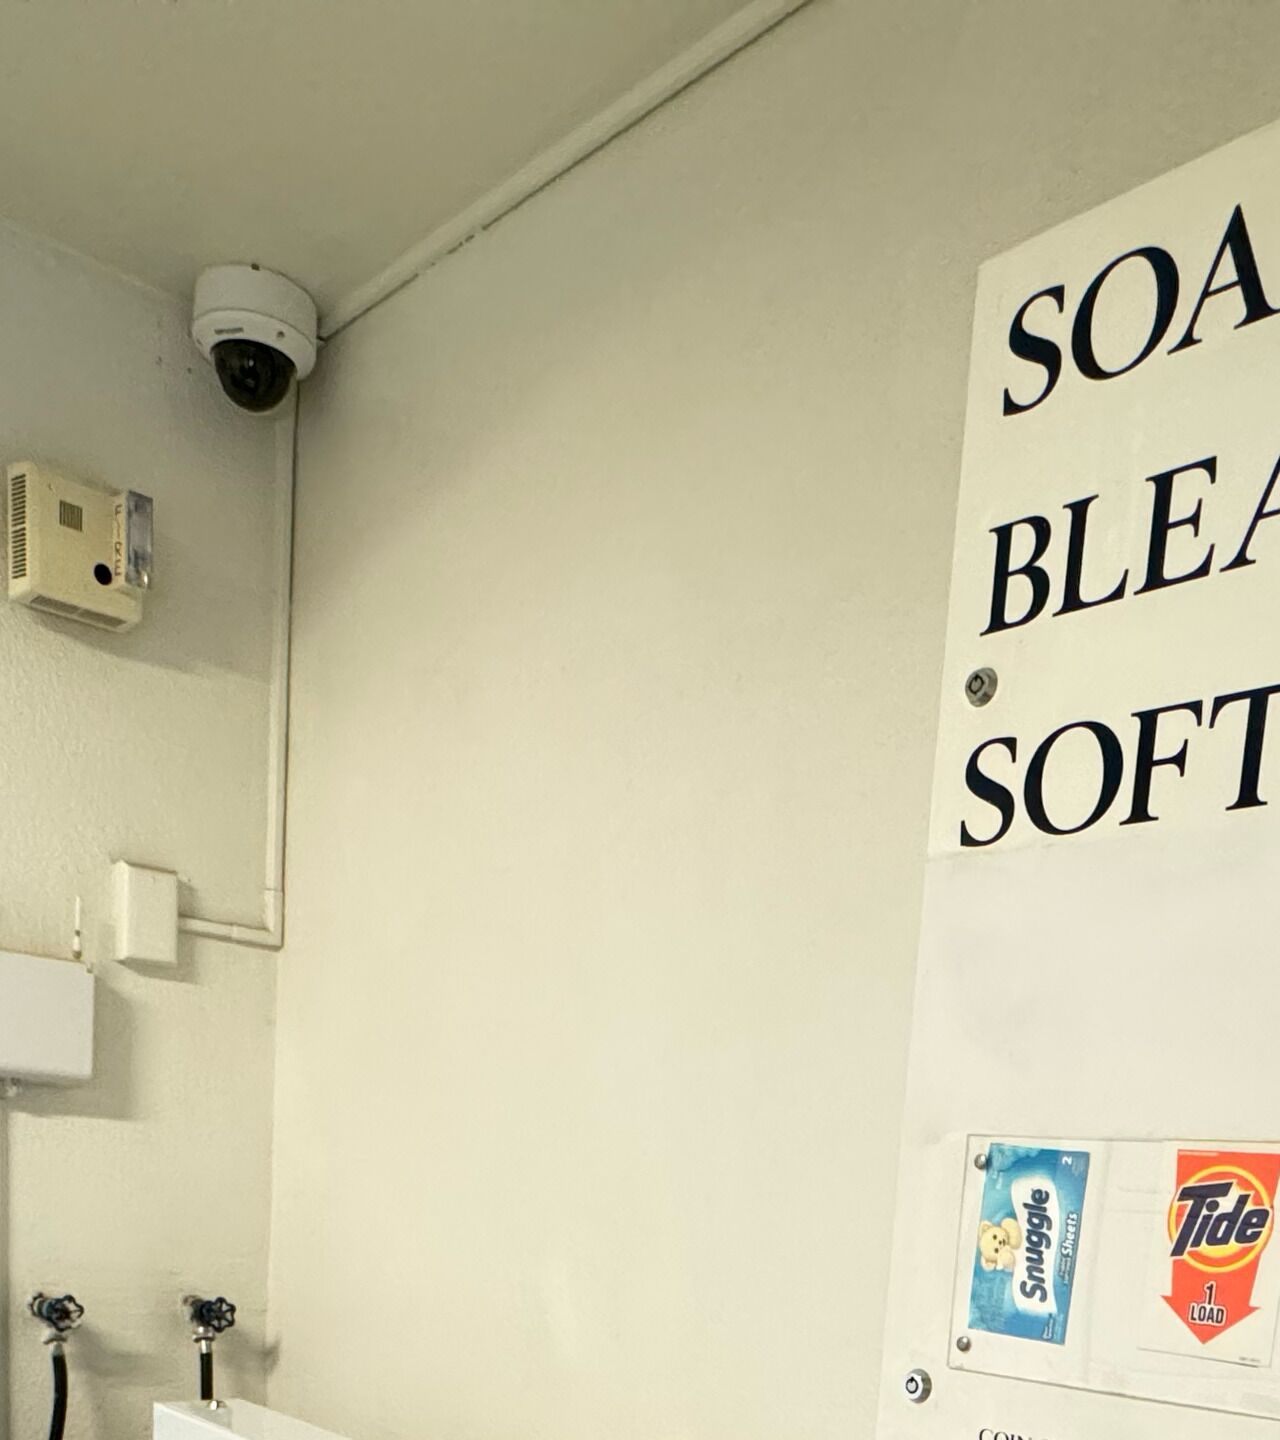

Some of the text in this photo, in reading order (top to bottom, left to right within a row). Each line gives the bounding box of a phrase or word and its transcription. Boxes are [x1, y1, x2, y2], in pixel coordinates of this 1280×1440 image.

[114, 503, 123, 576] FIRE
[1061, 1156, 1073, 1166] 2
[1061, 1213, 1078, 1259] Sheets
[1170, 1181, 1270, 1257] Tide
[1020, 1187, 1053, 1303] Snuggle
[1190, 1305, 1225, 1325] LOAD
[1205, 1283, 1215, 1305] 1
